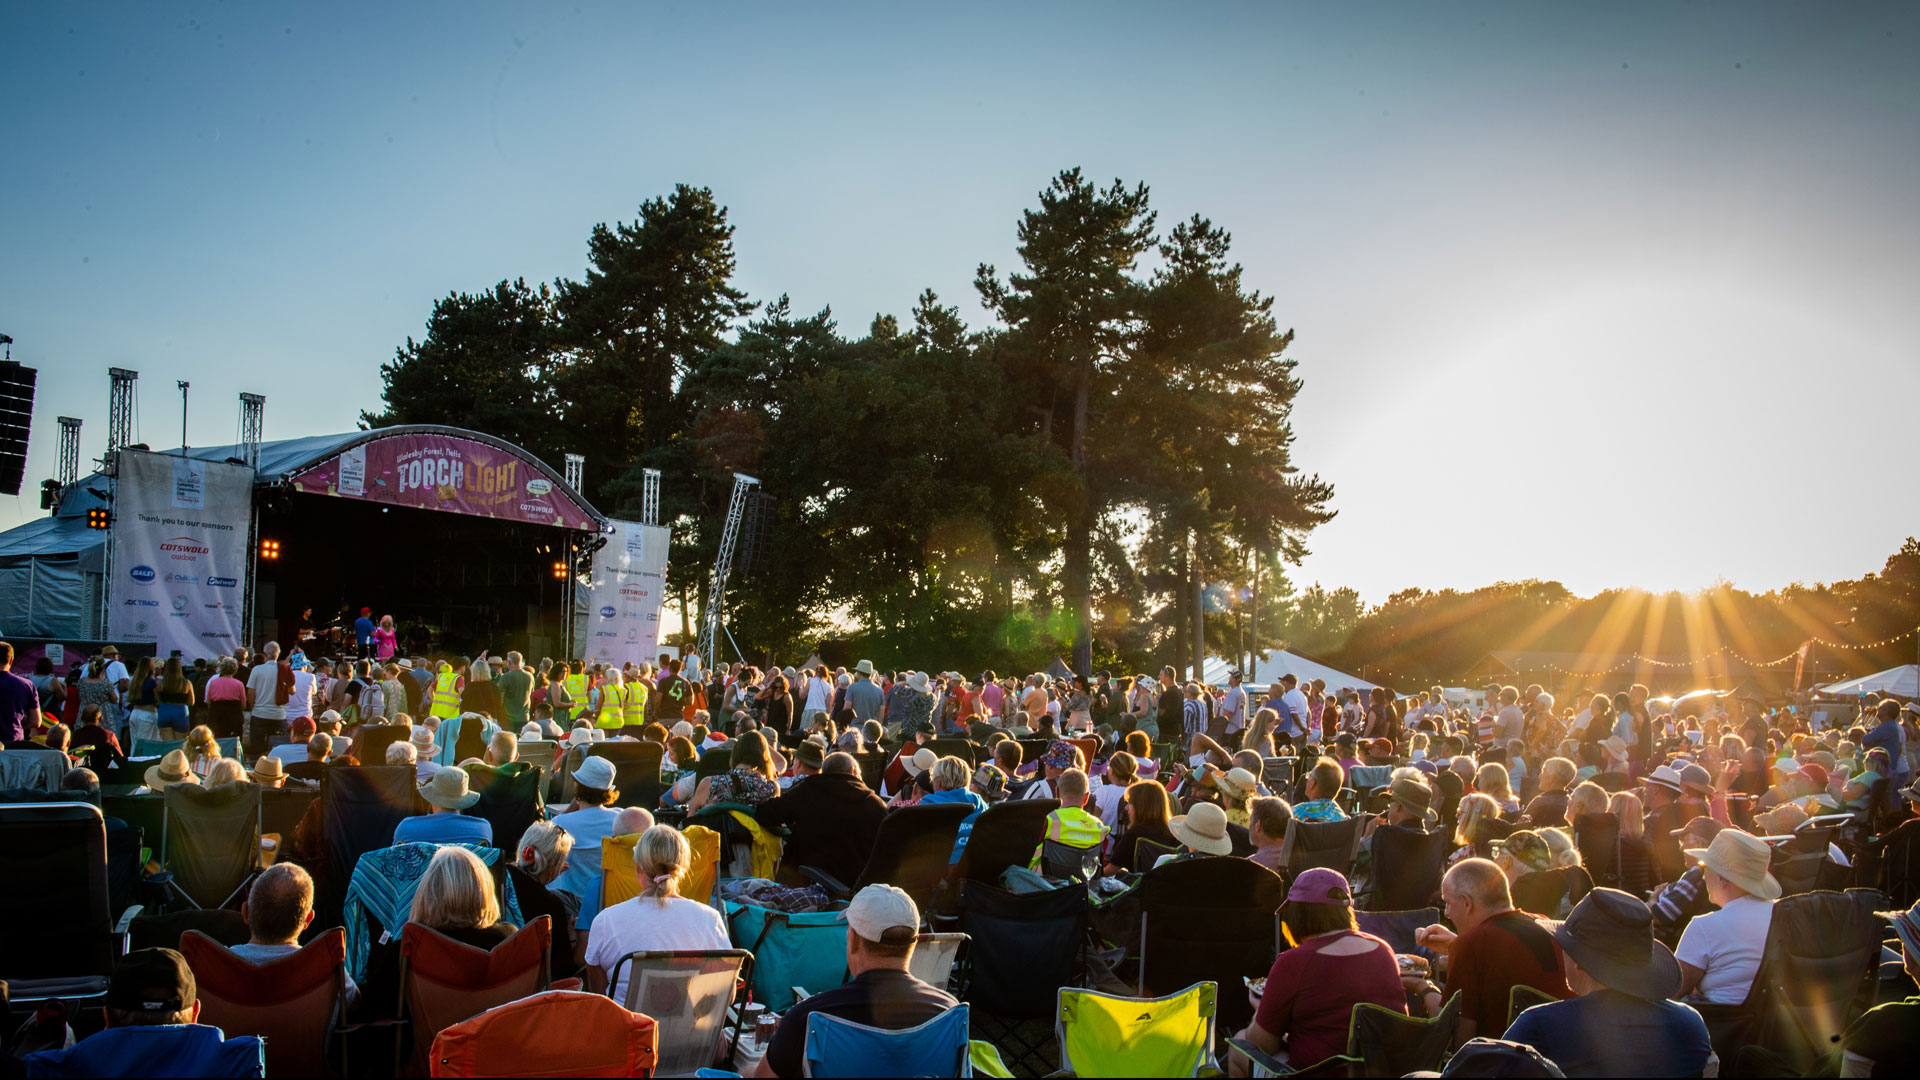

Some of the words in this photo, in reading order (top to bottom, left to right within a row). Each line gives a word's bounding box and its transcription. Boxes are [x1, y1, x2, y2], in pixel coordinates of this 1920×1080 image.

[397, 450, 422, 463] Walesby
[445, 448, 461, 458] Notts
[520, 504, 553, 514] COTSWOLD
[138, 513, 160, 523] Thank
[201, 522, 234, 531] sponsors
[160, 543, 209, 554] COTSWOLD
[171, 553, 197, 562] outdoor
[131, 569, 154, 577] BAILEY
[619, 588, 648, 597] COTSWOLD
[138, 599, 159, 607] TRACK
[1067, 831, 1093, 841] CREW
